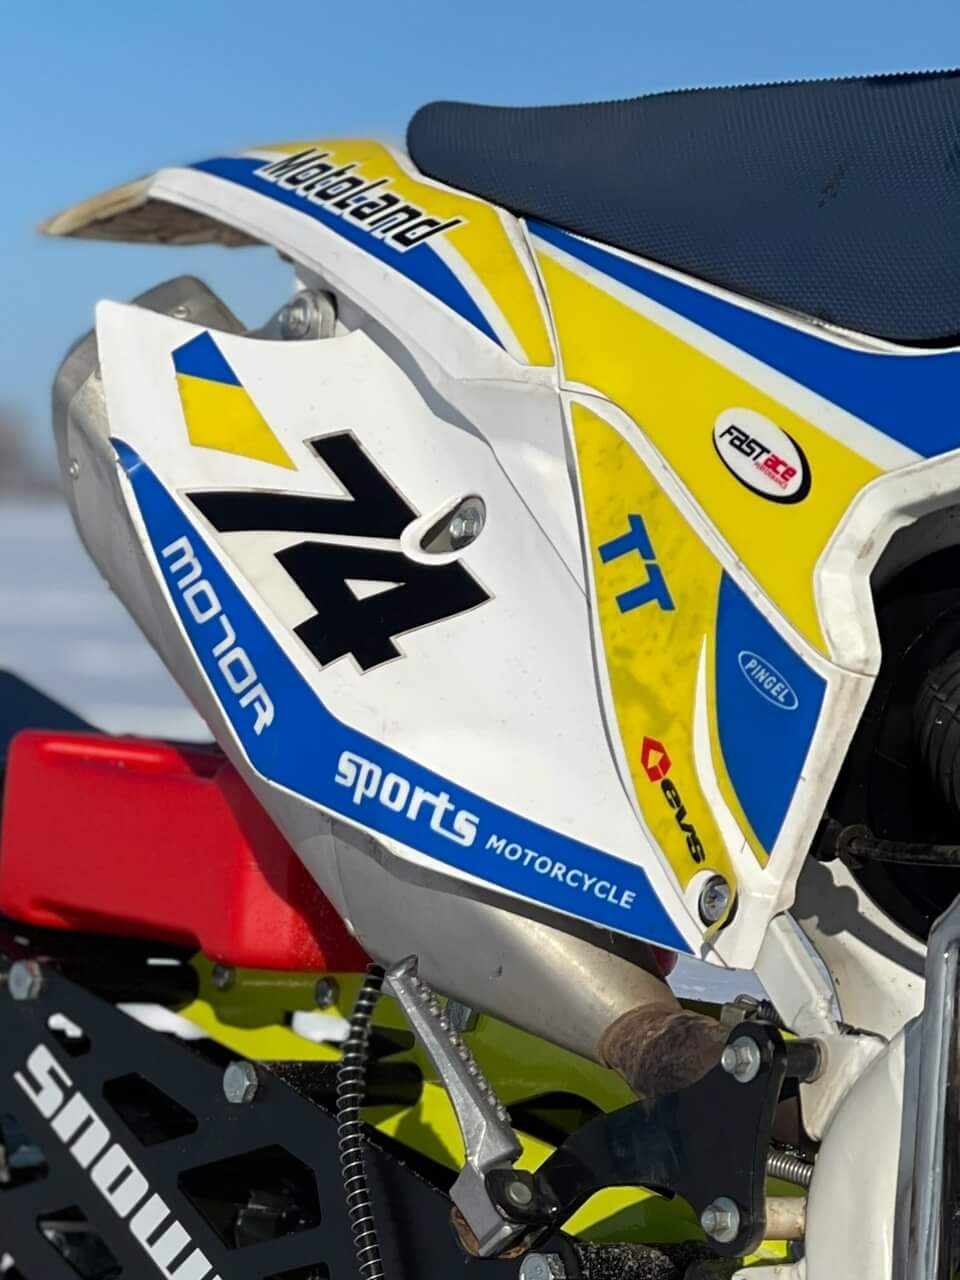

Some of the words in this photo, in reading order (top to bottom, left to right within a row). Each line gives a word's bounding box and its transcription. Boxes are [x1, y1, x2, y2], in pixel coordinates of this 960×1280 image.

[183, 432, 492, 672] 74
[598, 513, 675, 613] TT
[744, 658, 789, 702] PINGEL
[334, 750, 480, 847] sports
[485, 834, 637, 909] MOTORCYCLE
